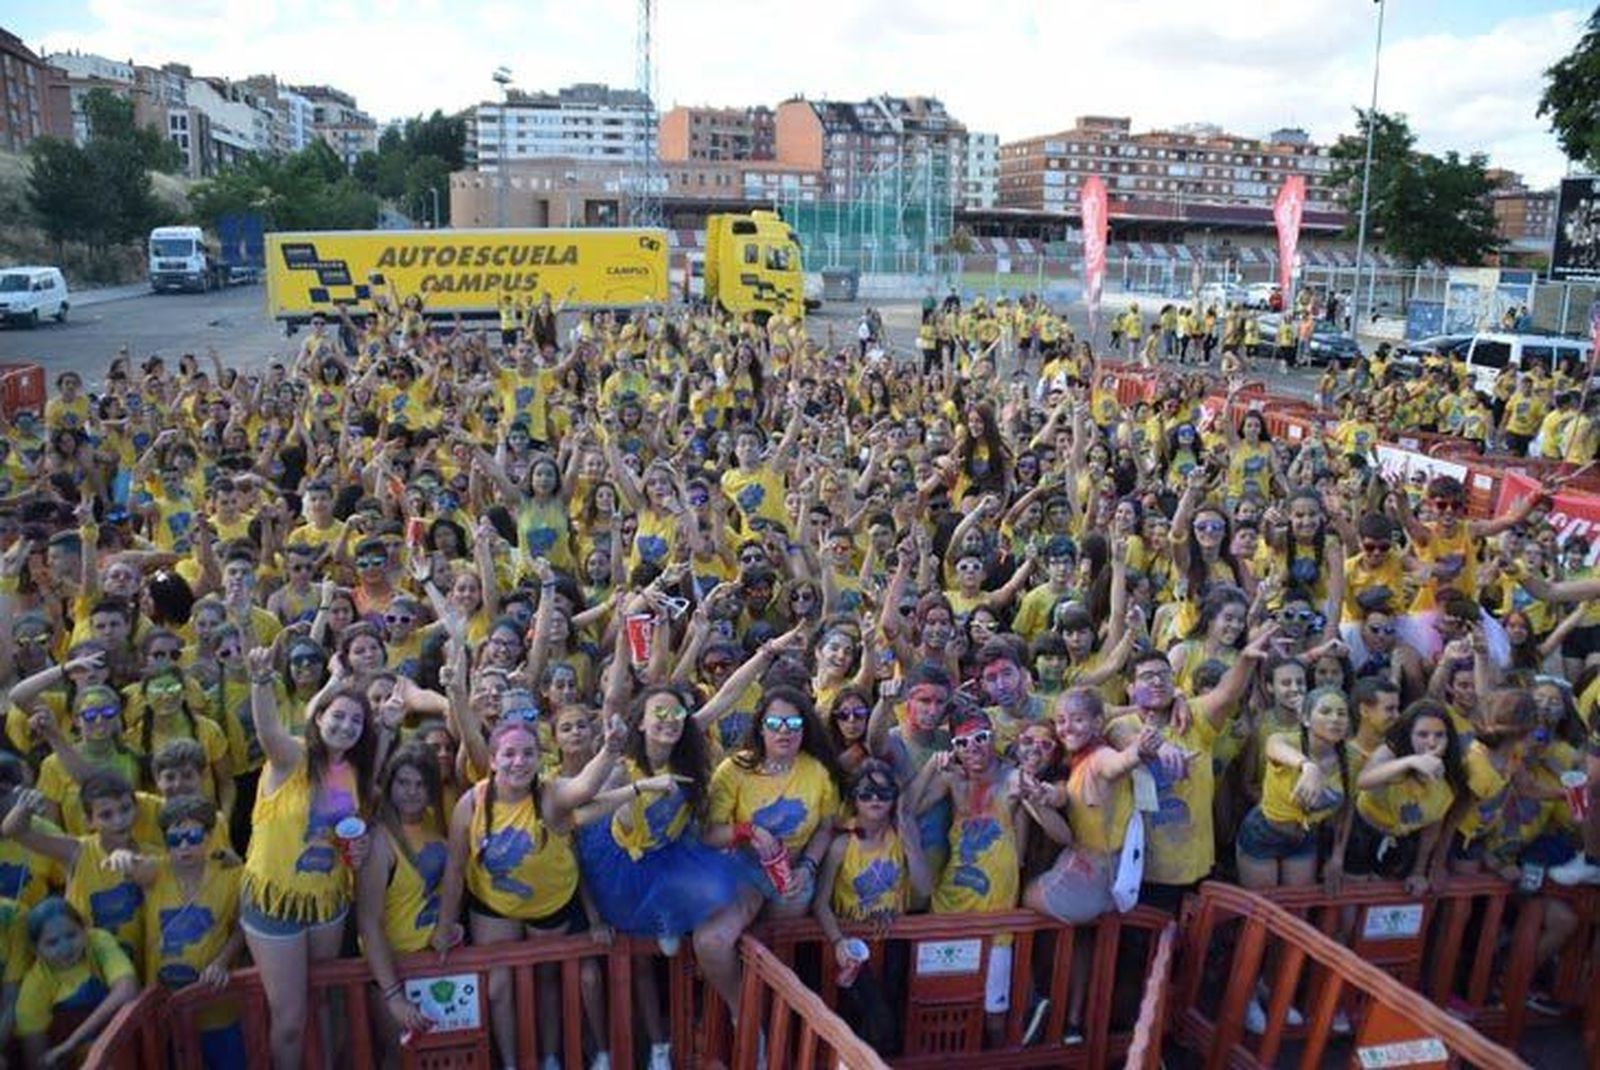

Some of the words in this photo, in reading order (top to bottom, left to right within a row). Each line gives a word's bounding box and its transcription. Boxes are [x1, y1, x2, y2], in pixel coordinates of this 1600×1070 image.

[377, 245, 579, 268] AUTOESCUELA
[606, 266, 649, 275] CAMPUS
[420, 272, 539, 293] CAMPUS
